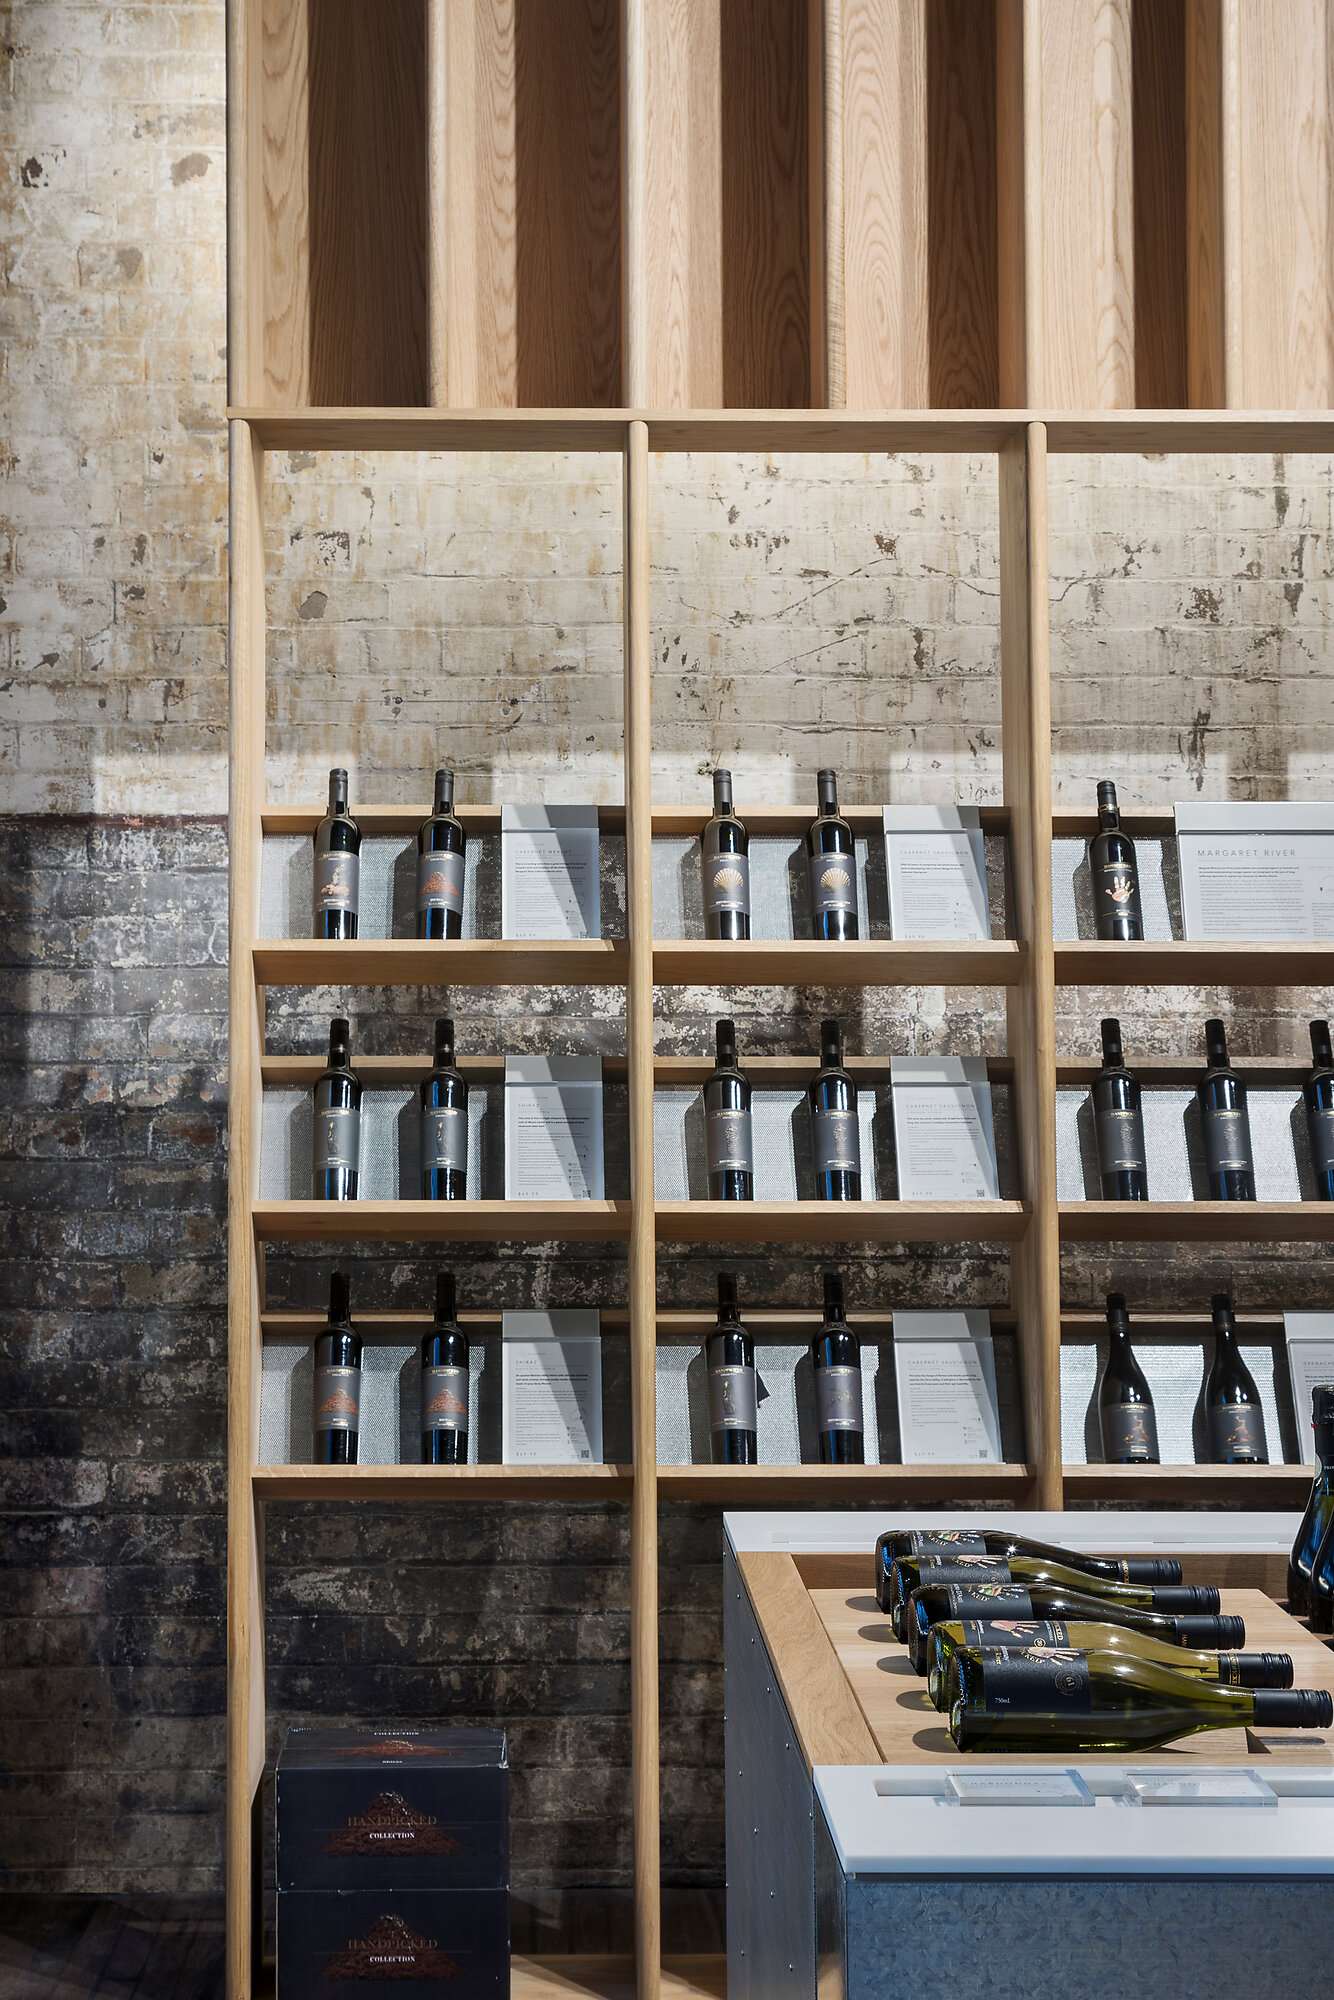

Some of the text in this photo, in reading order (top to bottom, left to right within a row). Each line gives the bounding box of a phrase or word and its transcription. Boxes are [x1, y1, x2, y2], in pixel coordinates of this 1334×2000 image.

[1197, 849, 1258, 857] MARGARET
[348, 1816, 438, 1826] HANDPICKED
[348, 1939, 438, 1950] HANDPICKED
[369, 1955, 415, 1963] COLLECTION
